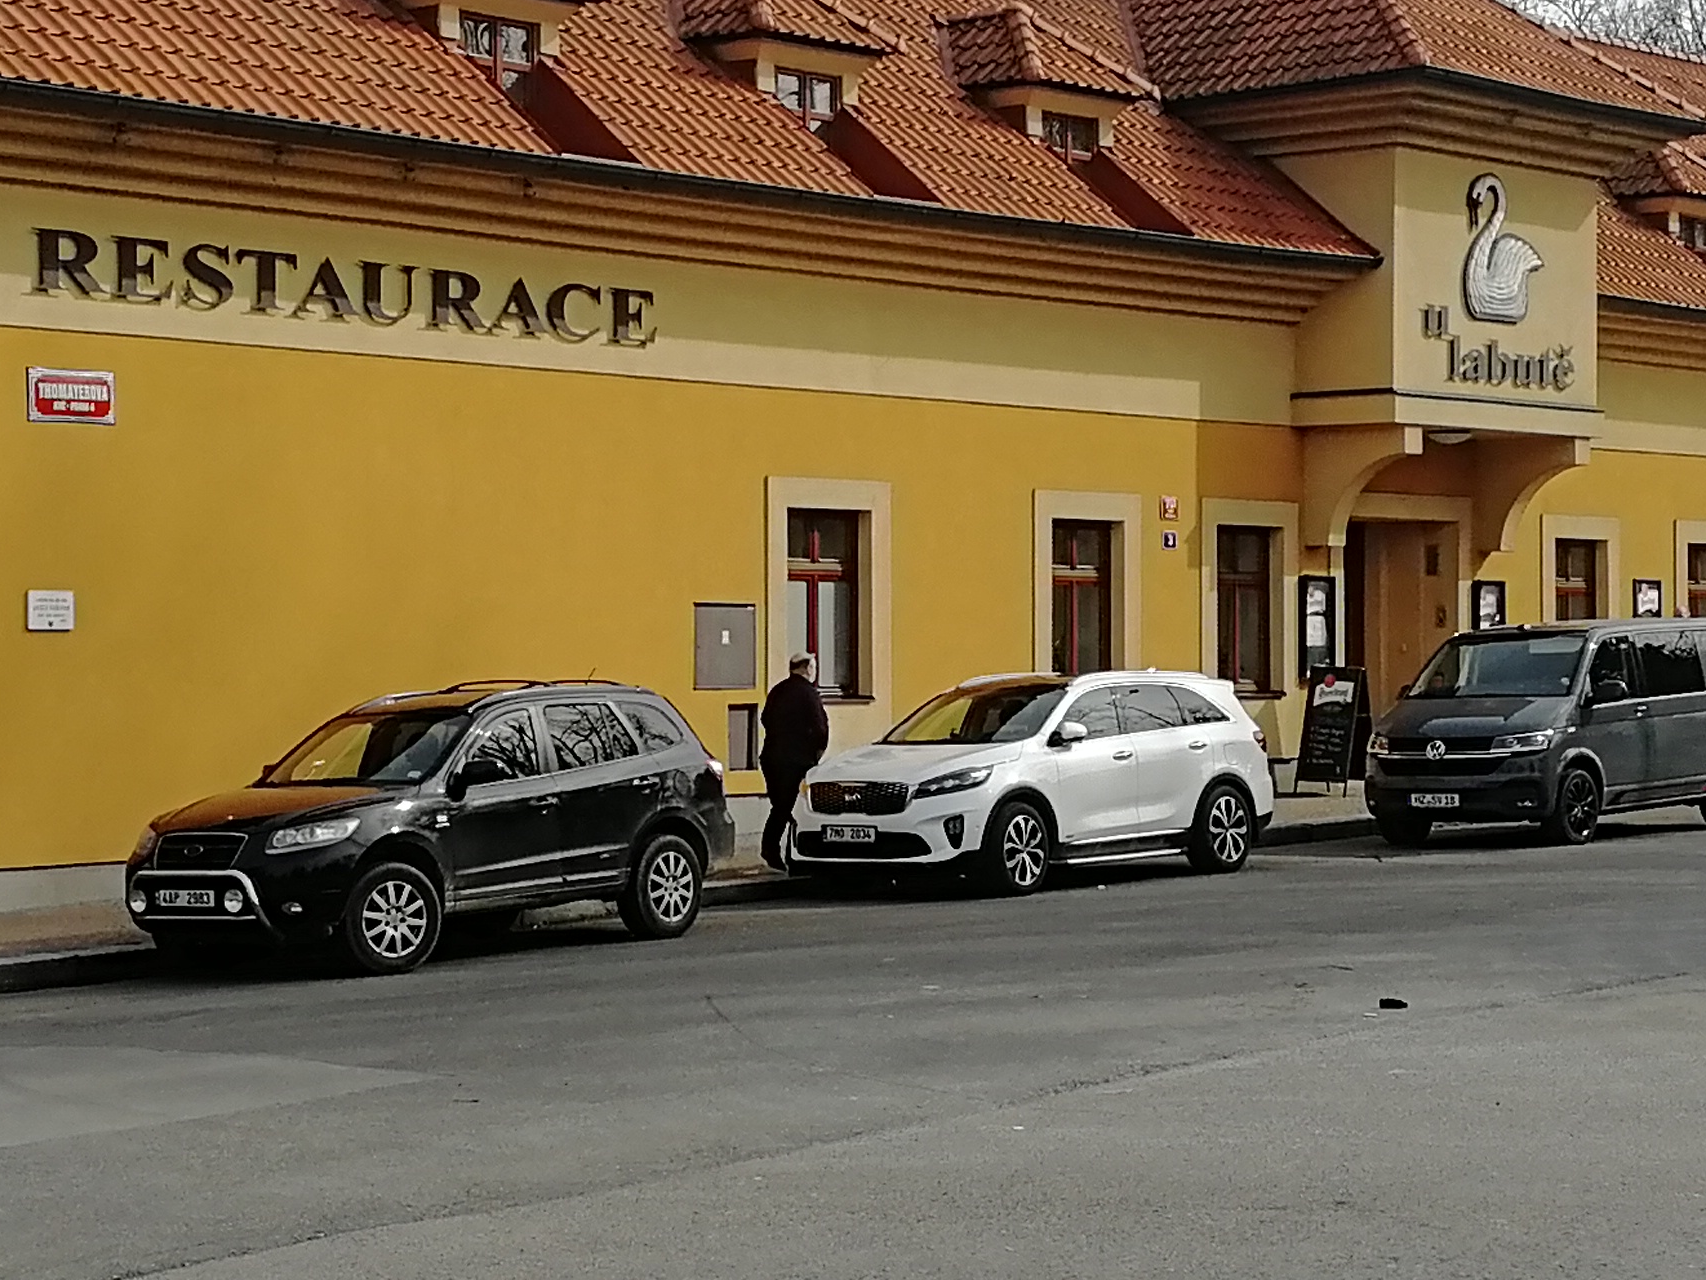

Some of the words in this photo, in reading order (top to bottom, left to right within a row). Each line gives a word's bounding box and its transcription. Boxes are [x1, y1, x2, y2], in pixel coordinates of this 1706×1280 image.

[24, 226, 658, 350] RESTAURACE
[37, 381, 109, 402] THOMAYEROVA
[1418, 302, 1450, 339] u
[1444, 334, 1576, 393] labutě
